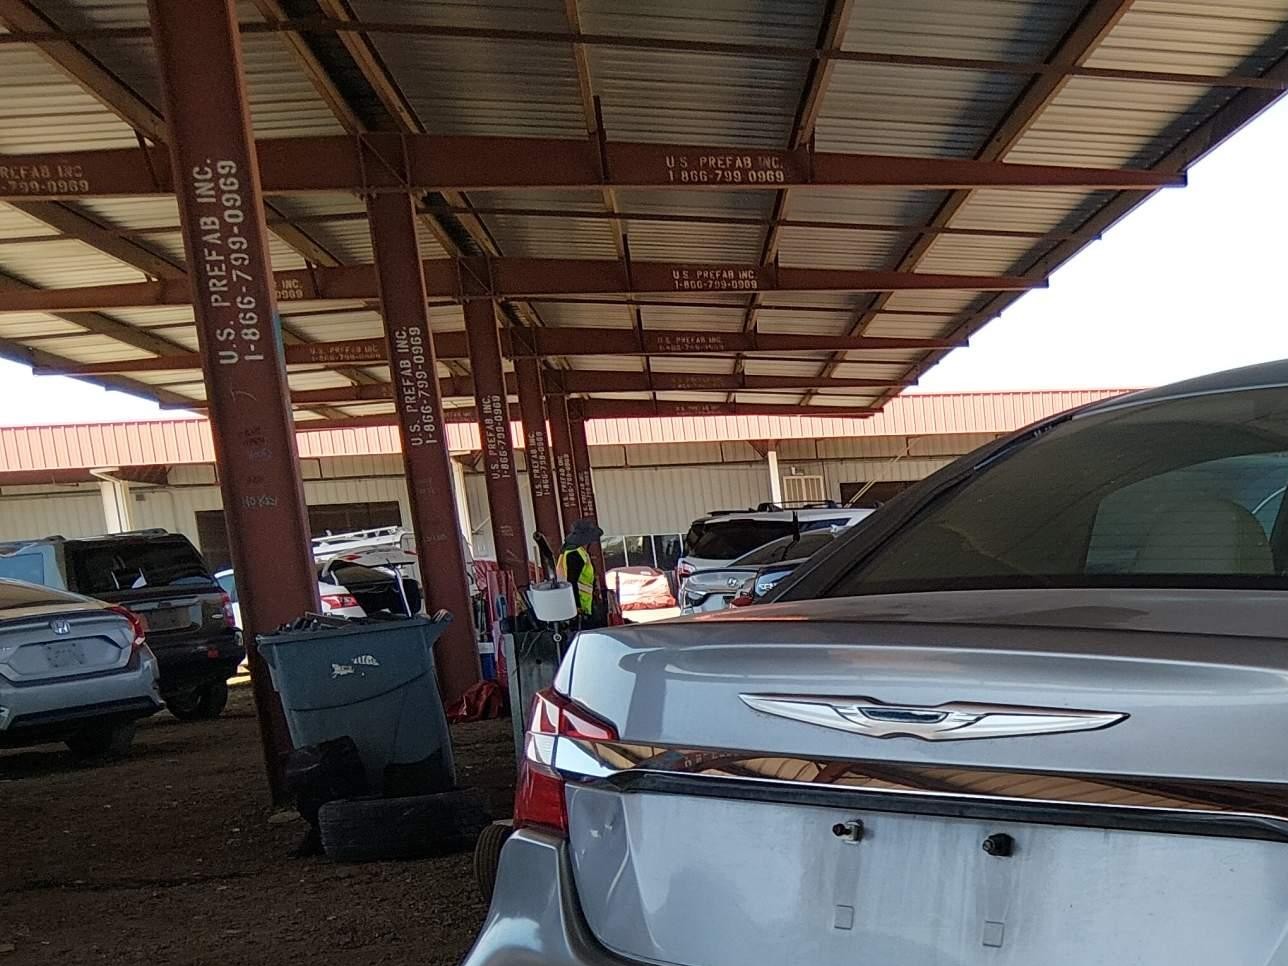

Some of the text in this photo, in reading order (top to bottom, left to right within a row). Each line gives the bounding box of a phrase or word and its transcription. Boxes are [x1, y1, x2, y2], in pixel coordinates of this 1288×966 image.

[0, 165, 50, 179] REFAB
[699, 155, 752, 169] PREFAB
[192, 158, 240, 365] U.S. PREFAB INC.
[216, 159, 264, 361] 1-866-799-0969
[394, 326, 424, 446] U.S. PREFAB INC.
[408, 327, 438, 444] 1-866-799-0969
[484, 417, 498, 456] PREFAB
